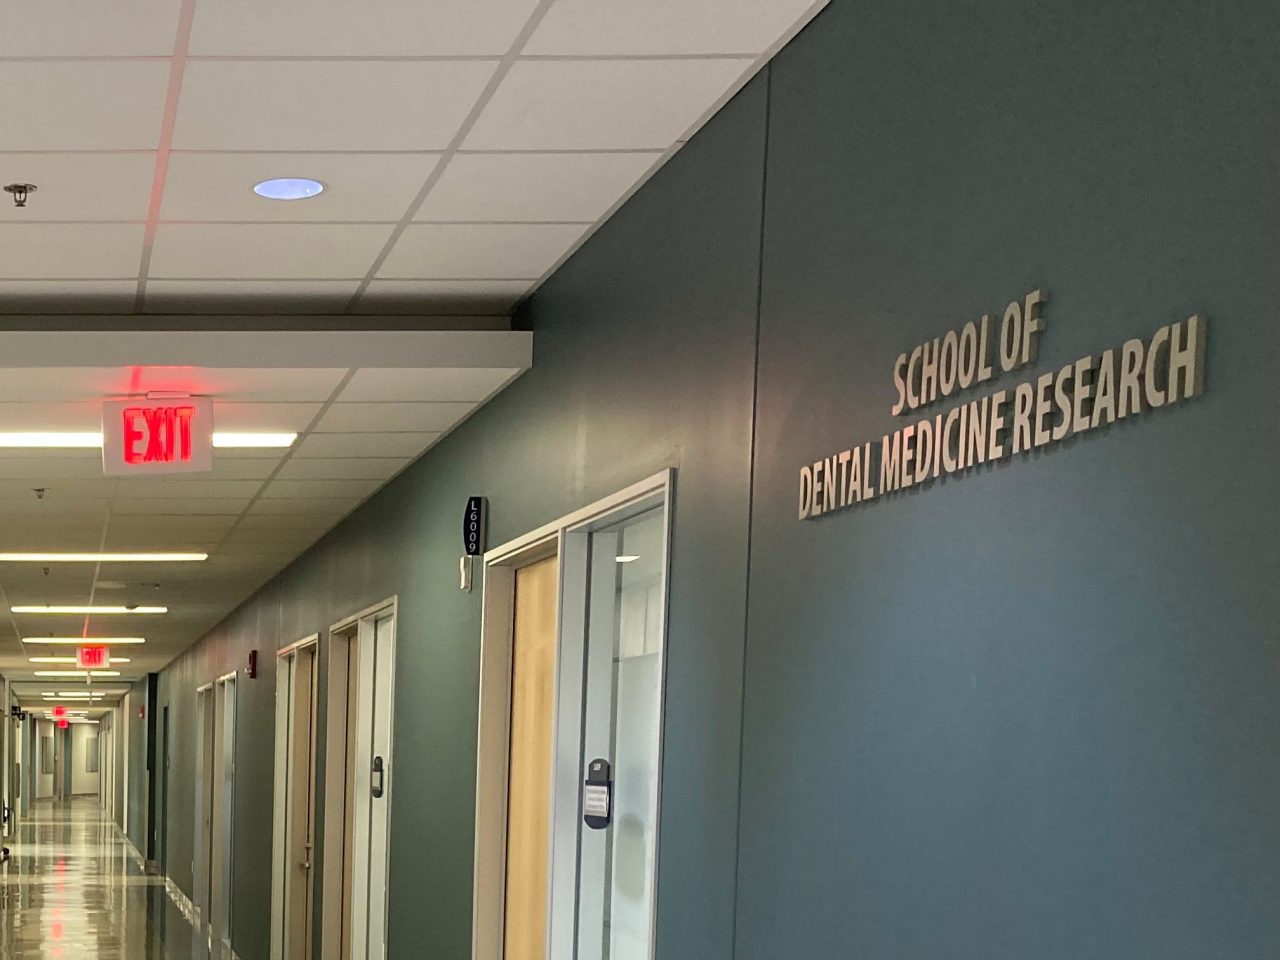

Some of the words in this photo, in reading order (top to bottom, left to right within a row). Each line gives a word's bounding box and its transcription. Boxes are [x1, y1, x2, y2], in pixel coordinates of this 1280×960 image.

[891, 313, 993, 416] SCHOOL
[999, 289, 1045, 373] OF
[123, 406, 195, 464] EXIT
[799, 442, 875, 520] DENTAL
[879, 390, 1007, 495] MEDICINE
[1012, 314, 1203, 455] RESEARCH
[469, 500, 478, 553] L6009
